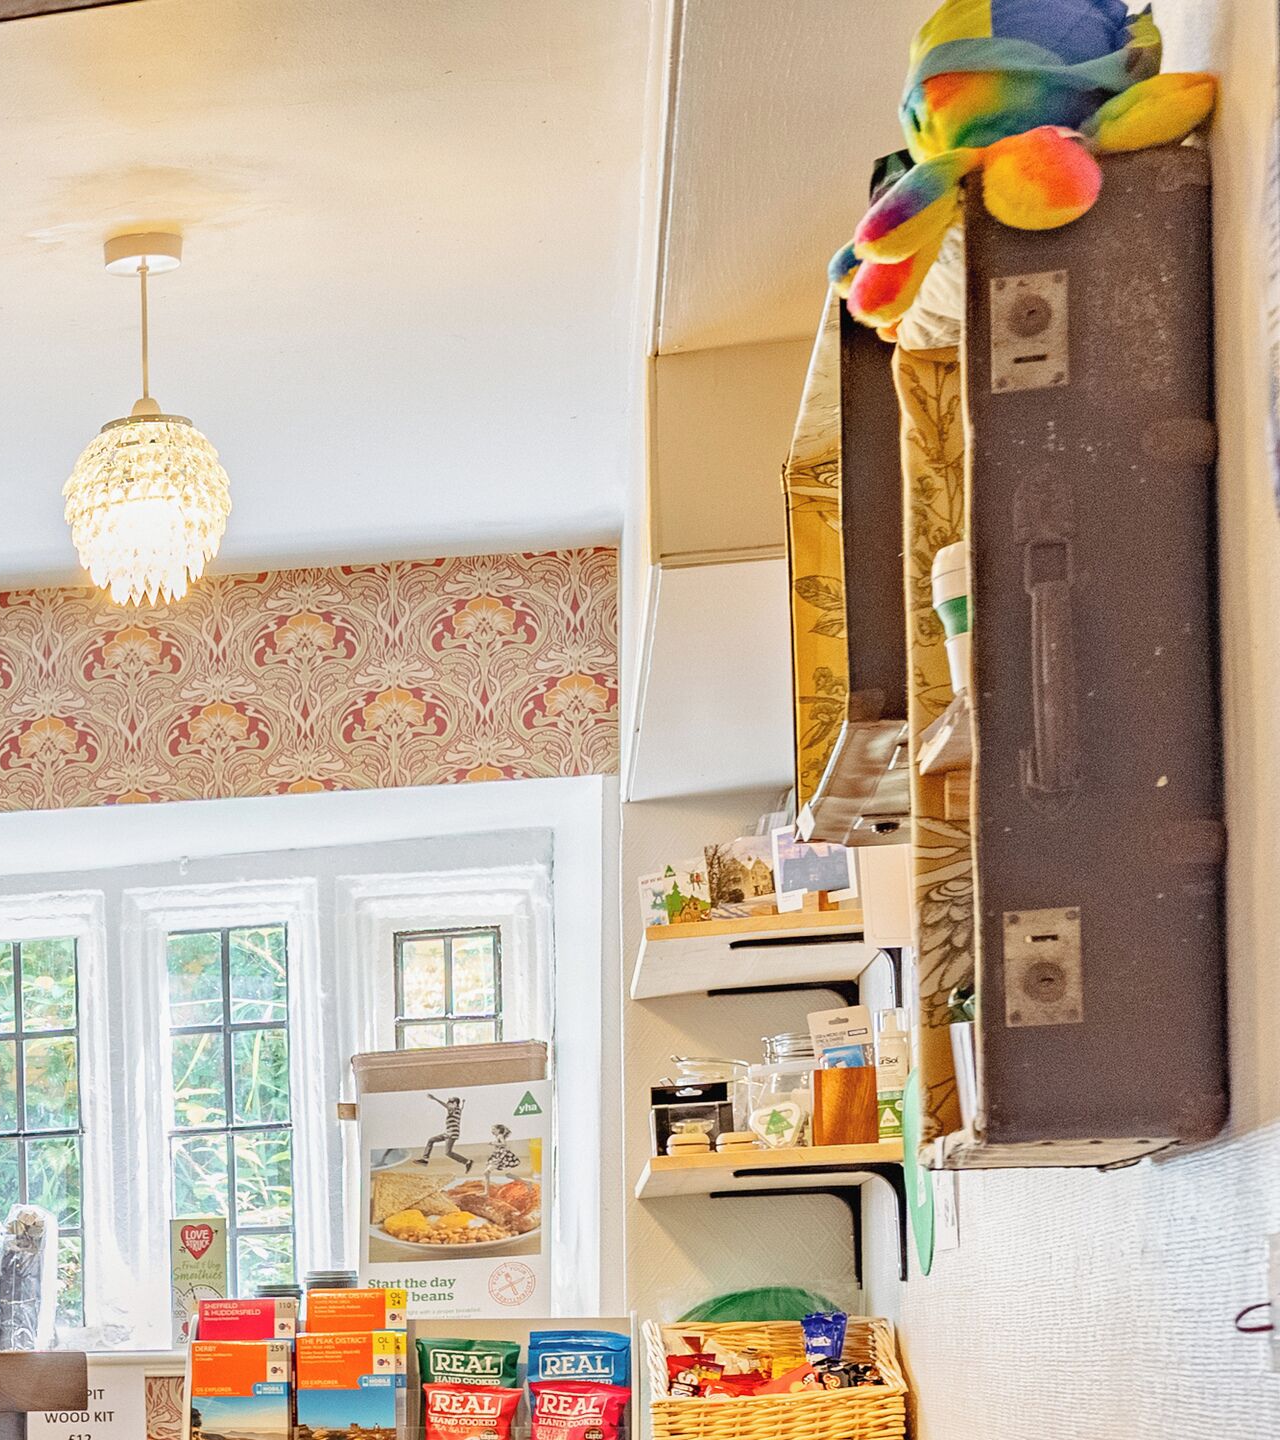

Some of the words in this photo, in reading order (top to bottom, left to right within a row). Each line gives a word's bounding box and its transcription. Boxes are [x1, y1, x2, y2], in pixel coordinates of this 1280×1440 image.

[518, 1103, 537, 1113] yha
[185, 1230, 209, 1240] LOVE
[173, 1267, 223, 1281] Smoothies
[368, 1278, 402, 1289] Start
[404, 1278, 428, 1289] the
[430, 1277, 457, 1293] day
[412, 1291, 454, 1302] beans
[436, 1353, 499, 1374] REAL
[544, 1355, 610, 1375] REAL
[434, 1376, 462, 1385] HAND
[463, 1377, 501, 1386] COOKED
[433, 1392, 496, 1414] REAL
[541, 1394, 600, 1415] REAL
[44, 1412, 90, 1423] WOOD
[94, 1411, 115, 1422] KIT
[430, 1416, 458, 1426] HAND
[459, 1419, 497, 1427] COOKED
[538, 1418, 566, 1428] HAND
[567, 1418, 603, 1428] COOKED
